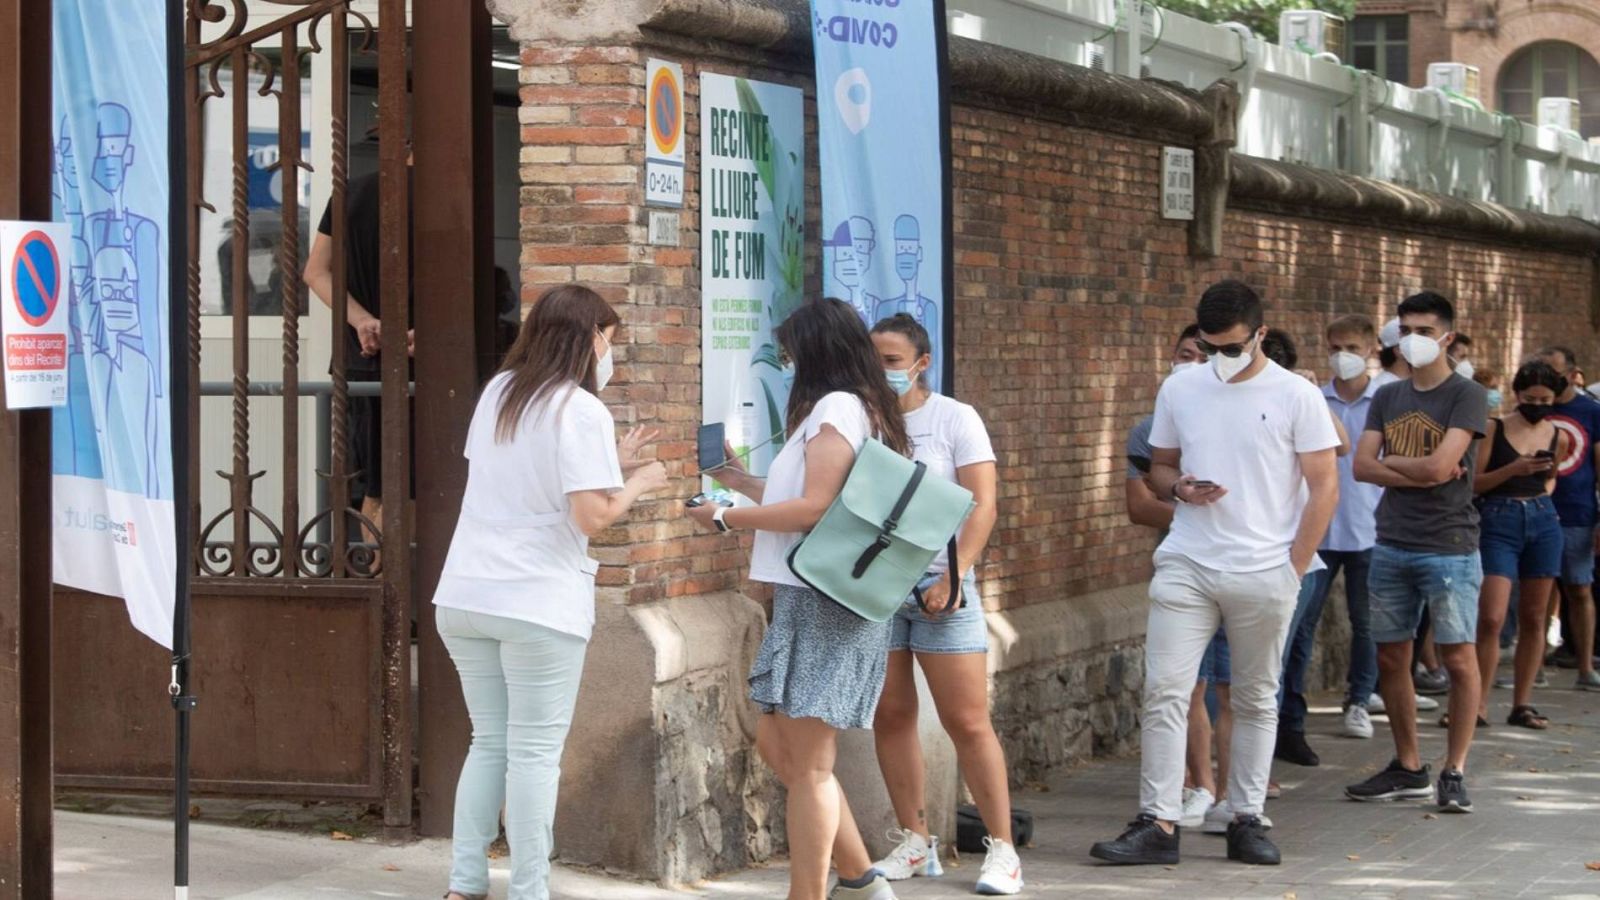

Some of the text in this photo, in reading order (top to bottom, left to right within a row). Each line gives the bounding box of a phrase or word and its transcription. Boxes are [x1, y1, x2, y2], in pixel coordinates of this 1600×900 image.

[710, 107, 769, 162] RECINTE
[711, 168, 759, 220] LLIURE
[711, 229, 730, 279] DE
[735, 231, 765, 280] FUM
[9, 337, 36, 349] Prohibit
[36, 353, 63, 366] Recinte
